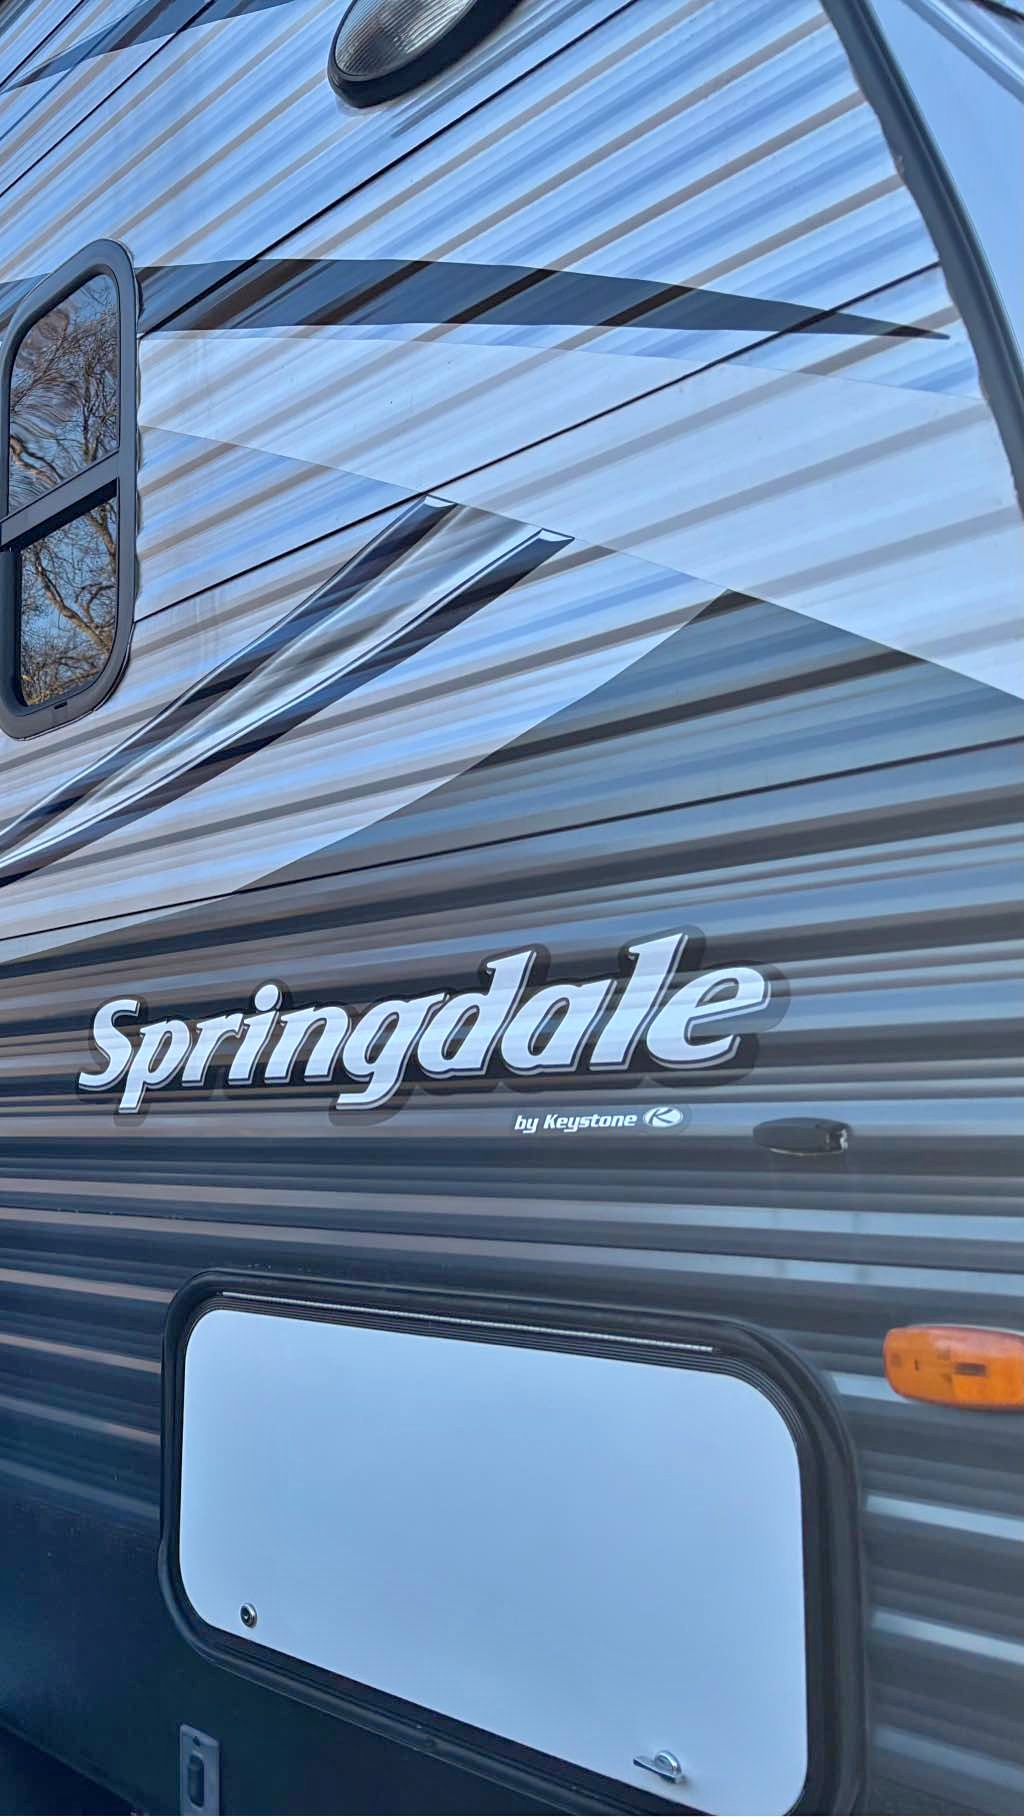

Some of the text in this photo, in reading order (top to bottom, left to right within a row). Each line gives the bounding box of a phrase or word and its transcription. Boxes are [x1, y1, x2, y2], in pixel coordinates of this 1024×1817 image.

[79, 933, 769, 1113] Springdale
[514, 1115, 538, 1133] by
[543, 1113, 637, 1132] Keystone
